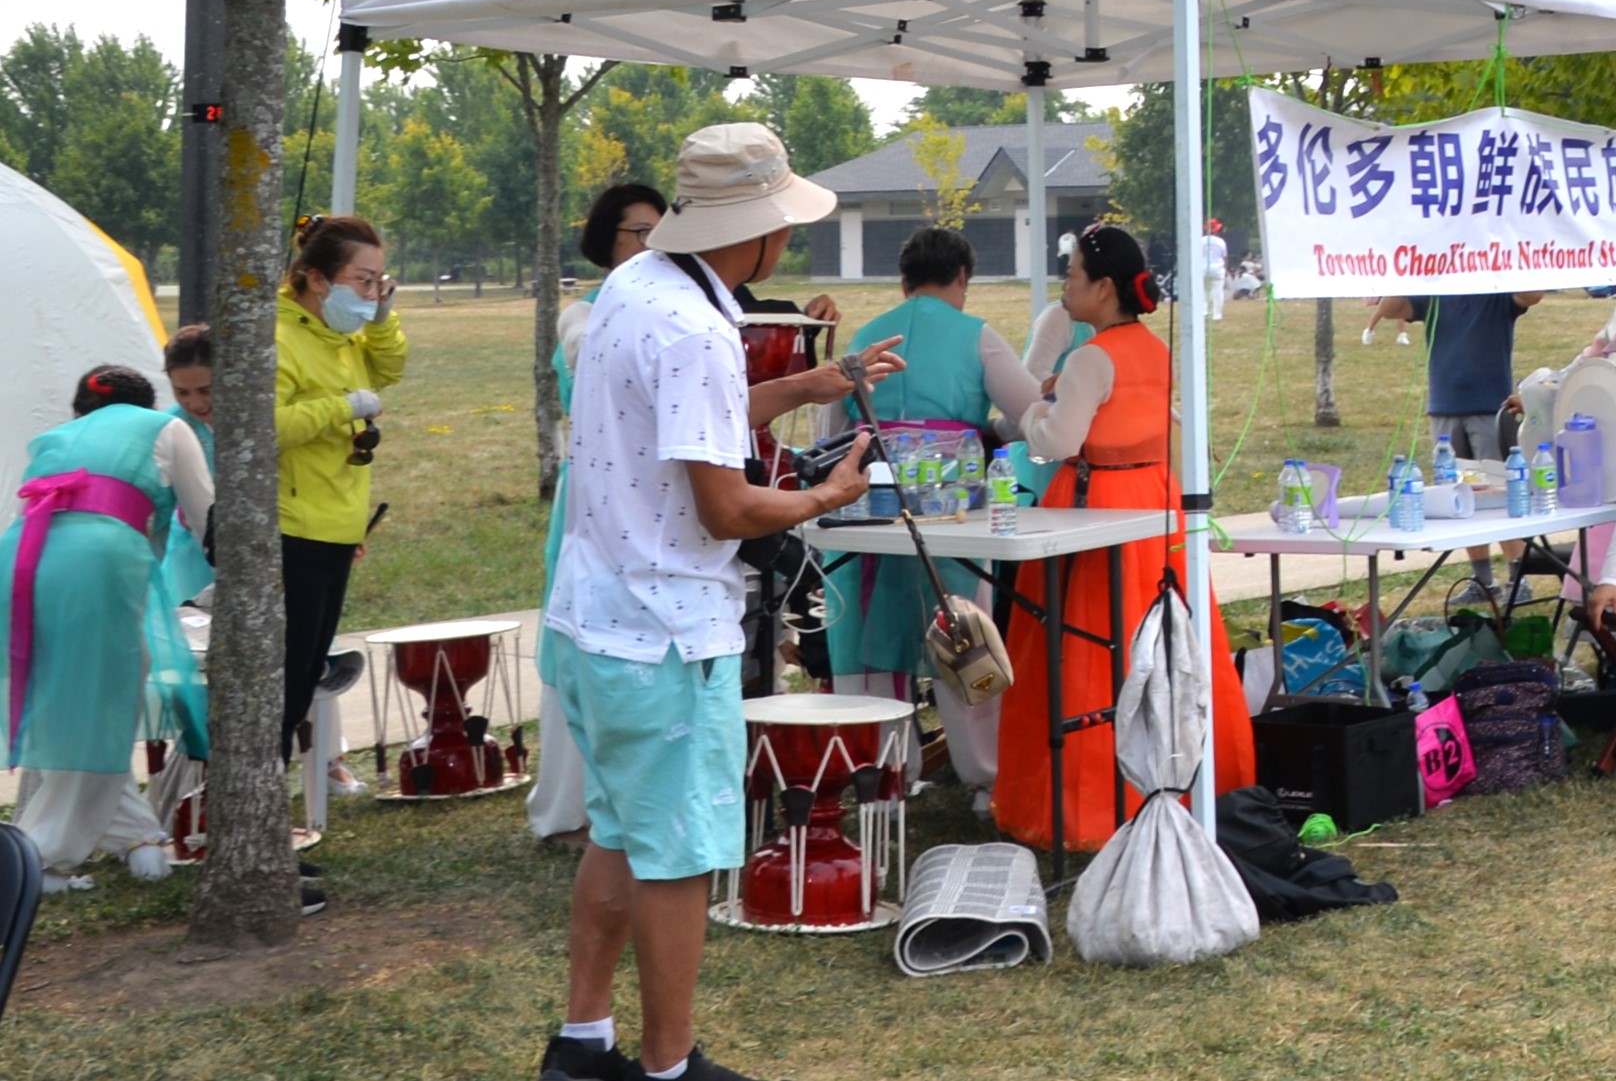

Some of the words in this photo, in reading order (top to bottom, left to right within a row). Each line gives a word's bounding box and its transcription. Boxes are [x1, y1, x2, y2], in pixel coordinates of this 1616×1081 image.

[1313, 243, 1387, 277] Toronto
[1393, 239, 1512, 277] ChaoXianZu
[1518, 239, 1595, 271] National
